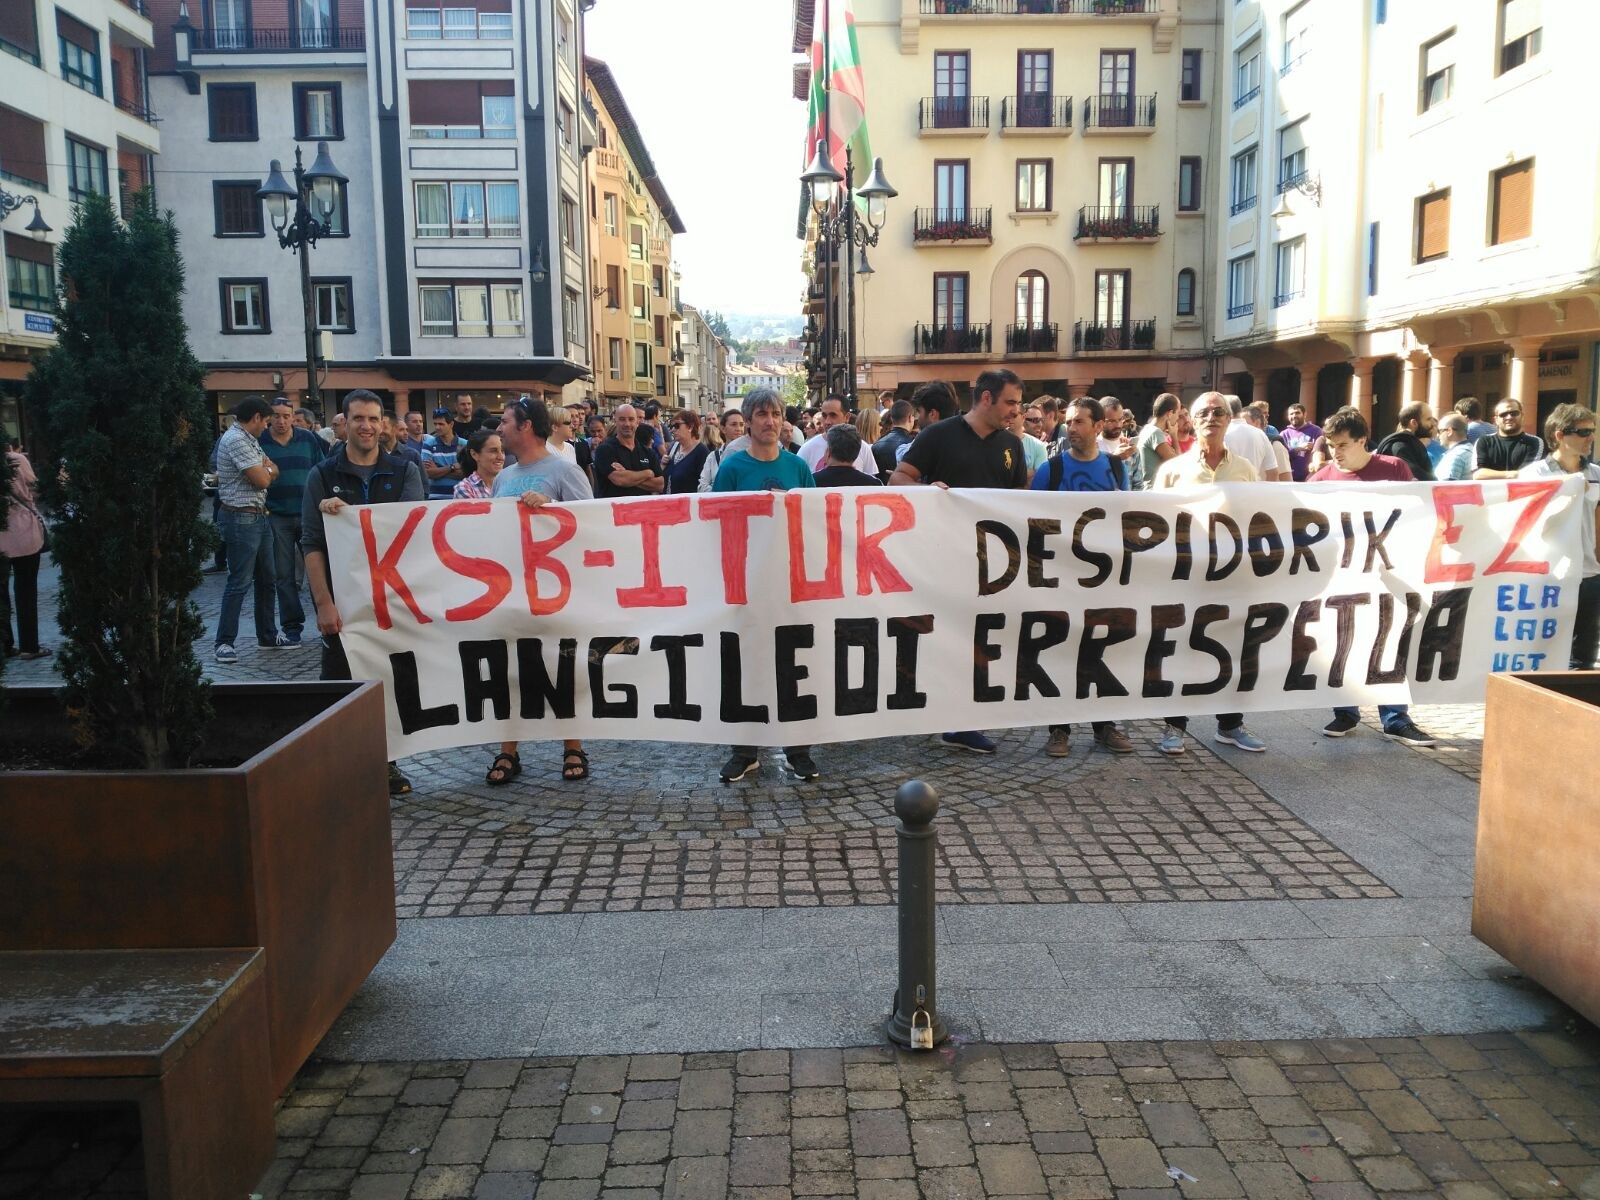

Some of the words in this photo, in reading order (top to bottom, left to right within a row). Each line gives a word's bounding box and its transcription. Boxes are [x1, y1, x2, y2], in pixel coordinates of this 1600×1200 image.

[358, 493, 916, 630] KSB-ITUR
[975, 507, 1402, 597] DESPIDORIK
[1423, 479, 1569, 584] EZ
[1497, 583, 1561, 612] ELA
[1494, 616, 1558, 642] LAB
[972, 587, 1473, 703] ERRESPETUA
[1492, 652, 1547, 673] UGT
